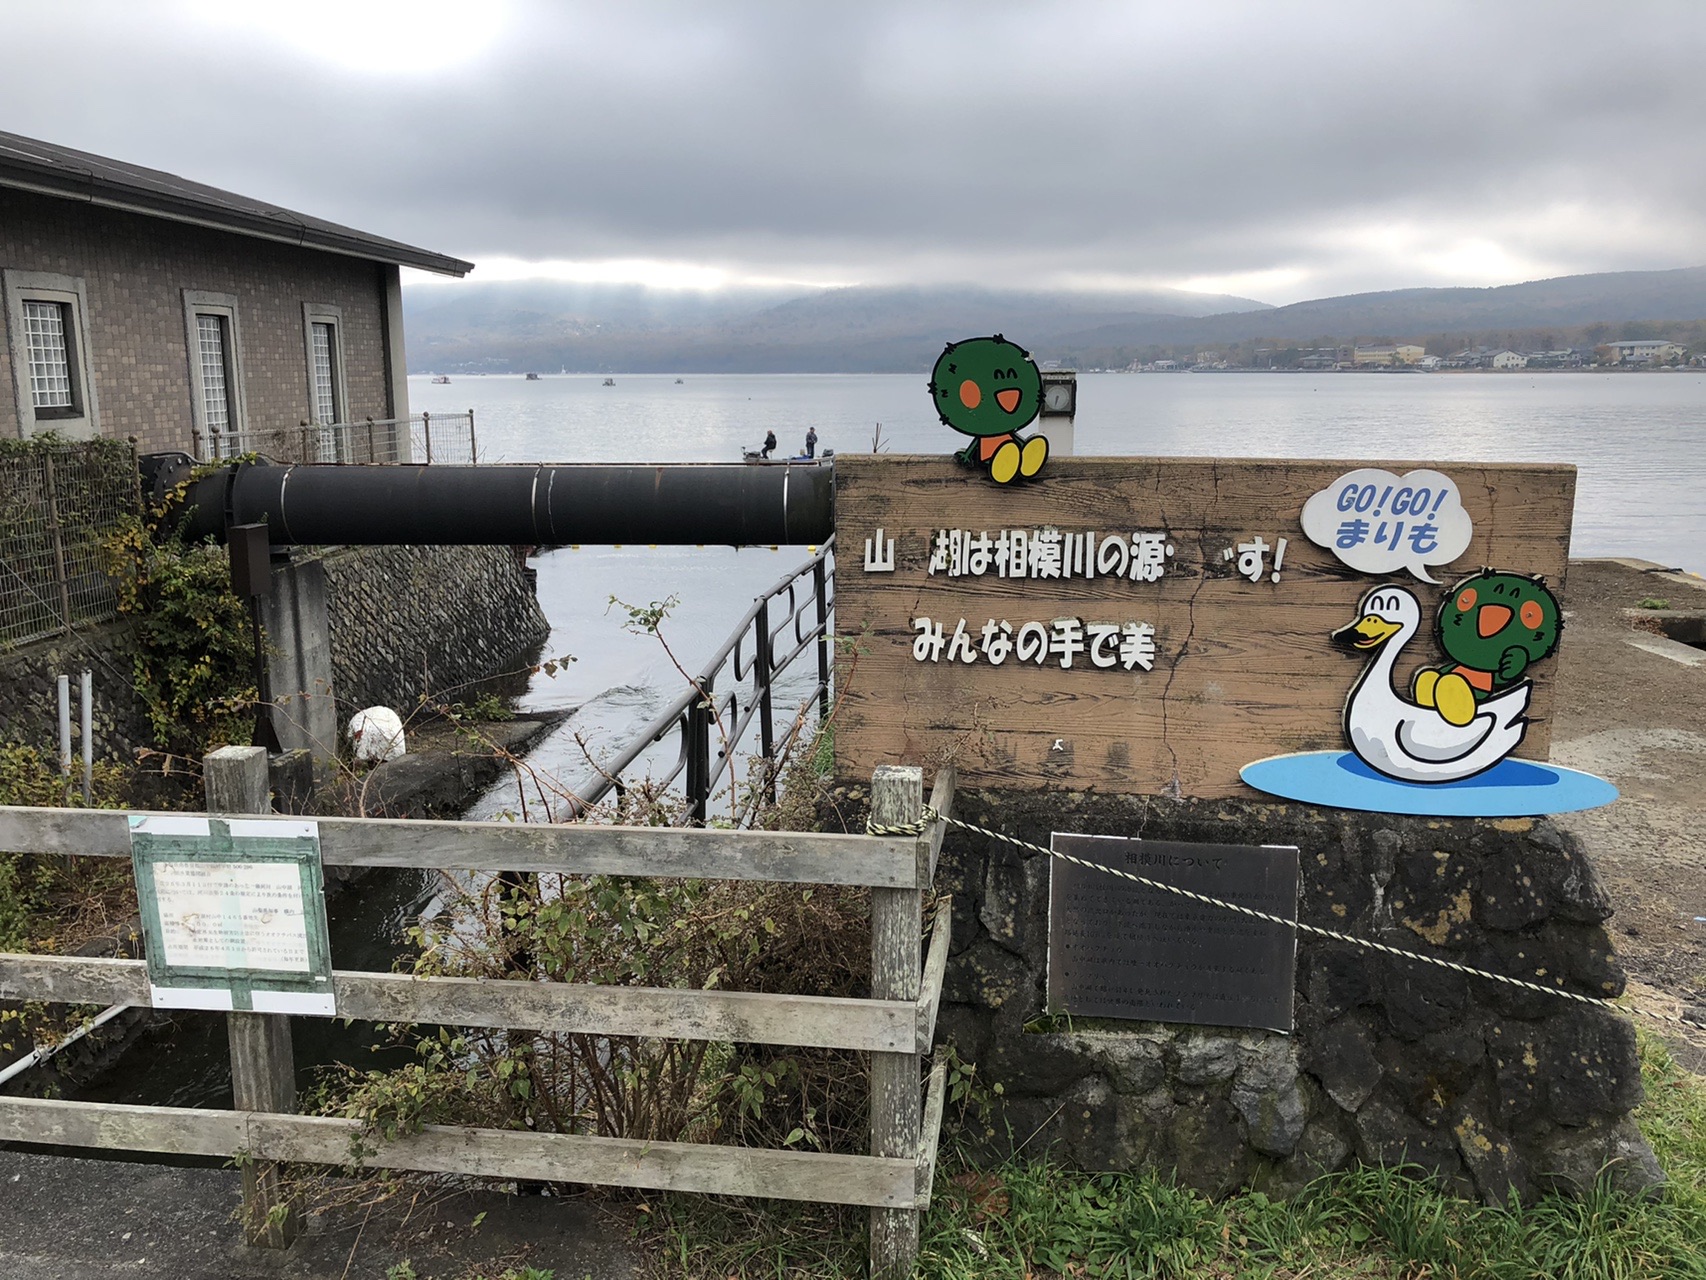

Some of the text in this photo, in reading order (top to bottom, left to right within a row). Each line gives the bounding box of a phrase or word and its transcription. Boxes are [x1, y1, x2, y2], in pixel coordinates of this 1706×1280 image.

[1336, 483, 1449, 521] GO!GO!
[1336, 518, 1439, 554] まりも
[912, 616, 1156, 671] みんなの手で美
[1124, 851, 1224, 871] 相模川について
